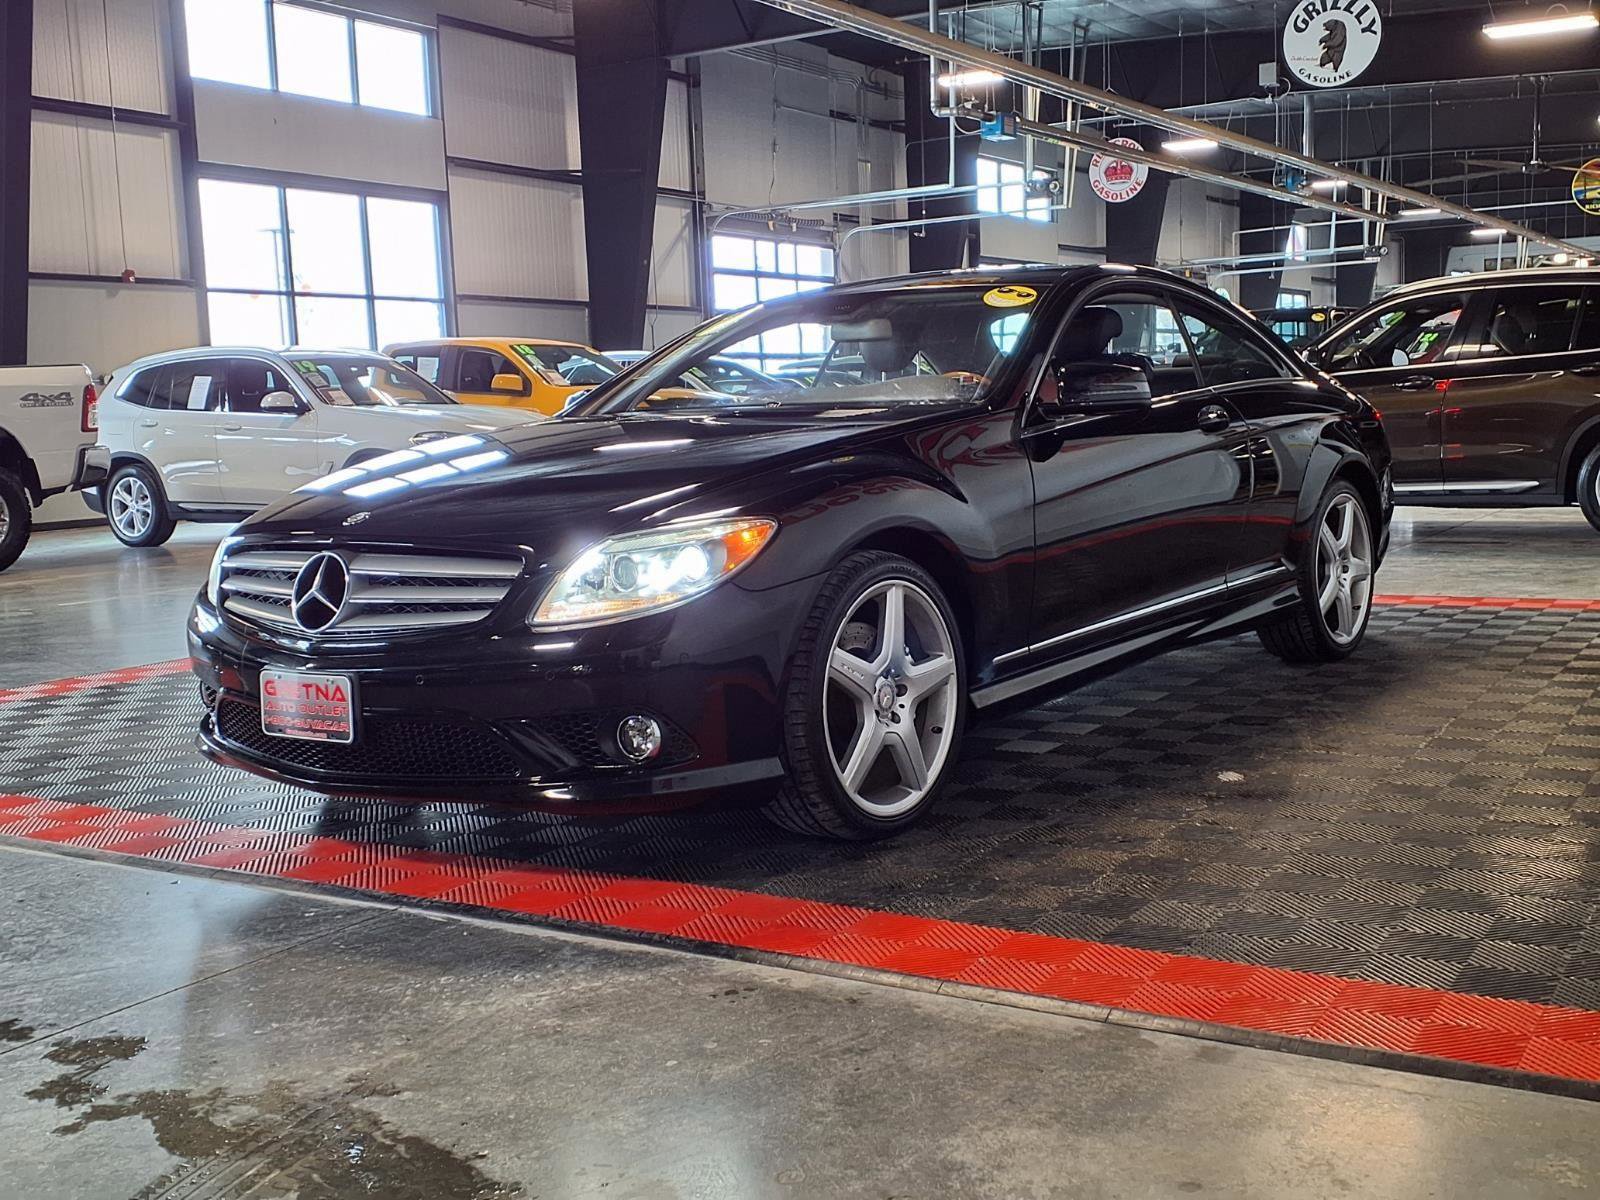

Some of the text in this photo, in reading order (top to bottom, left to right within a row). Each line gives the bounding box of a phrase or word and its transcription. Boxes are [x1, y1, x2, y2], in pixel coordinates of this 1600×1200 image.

[1293, 0, 1377, 35] GRIZZLY
[1298, 68, 1352, 83] GASOLINE
[1092, 179, 1143, 201] GASOLINE
[263, 679, 347, 703] GTNA
